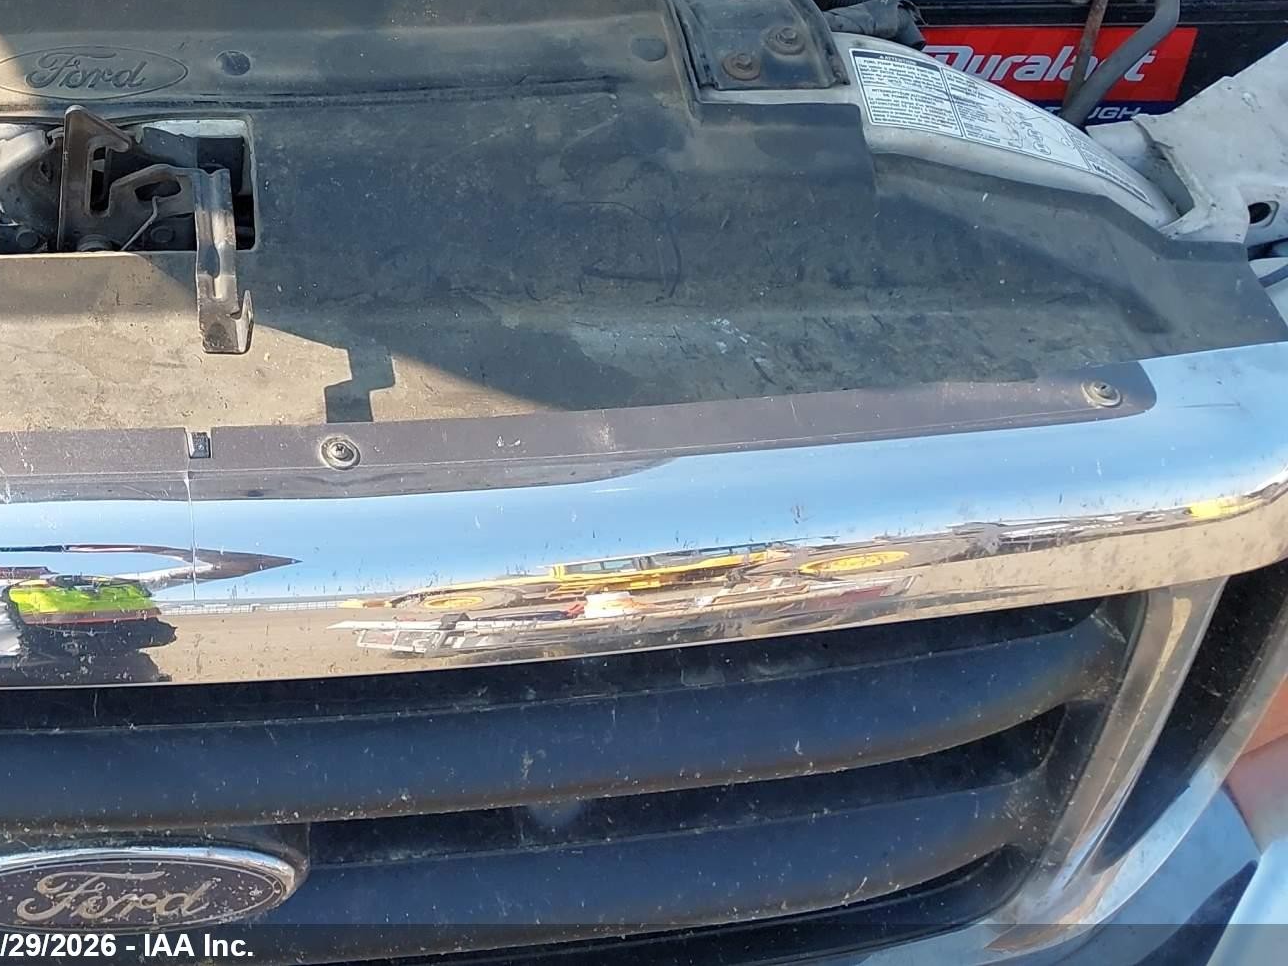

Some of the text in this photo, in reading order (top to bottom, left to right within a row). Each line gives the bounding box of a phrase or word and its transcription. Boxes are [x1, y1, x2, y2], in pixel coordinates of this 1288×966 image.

[25, 52, 148, 89] Ford
[923, 45, 1158, 82] Duralat
[17, 870, 213, 921] Ford
